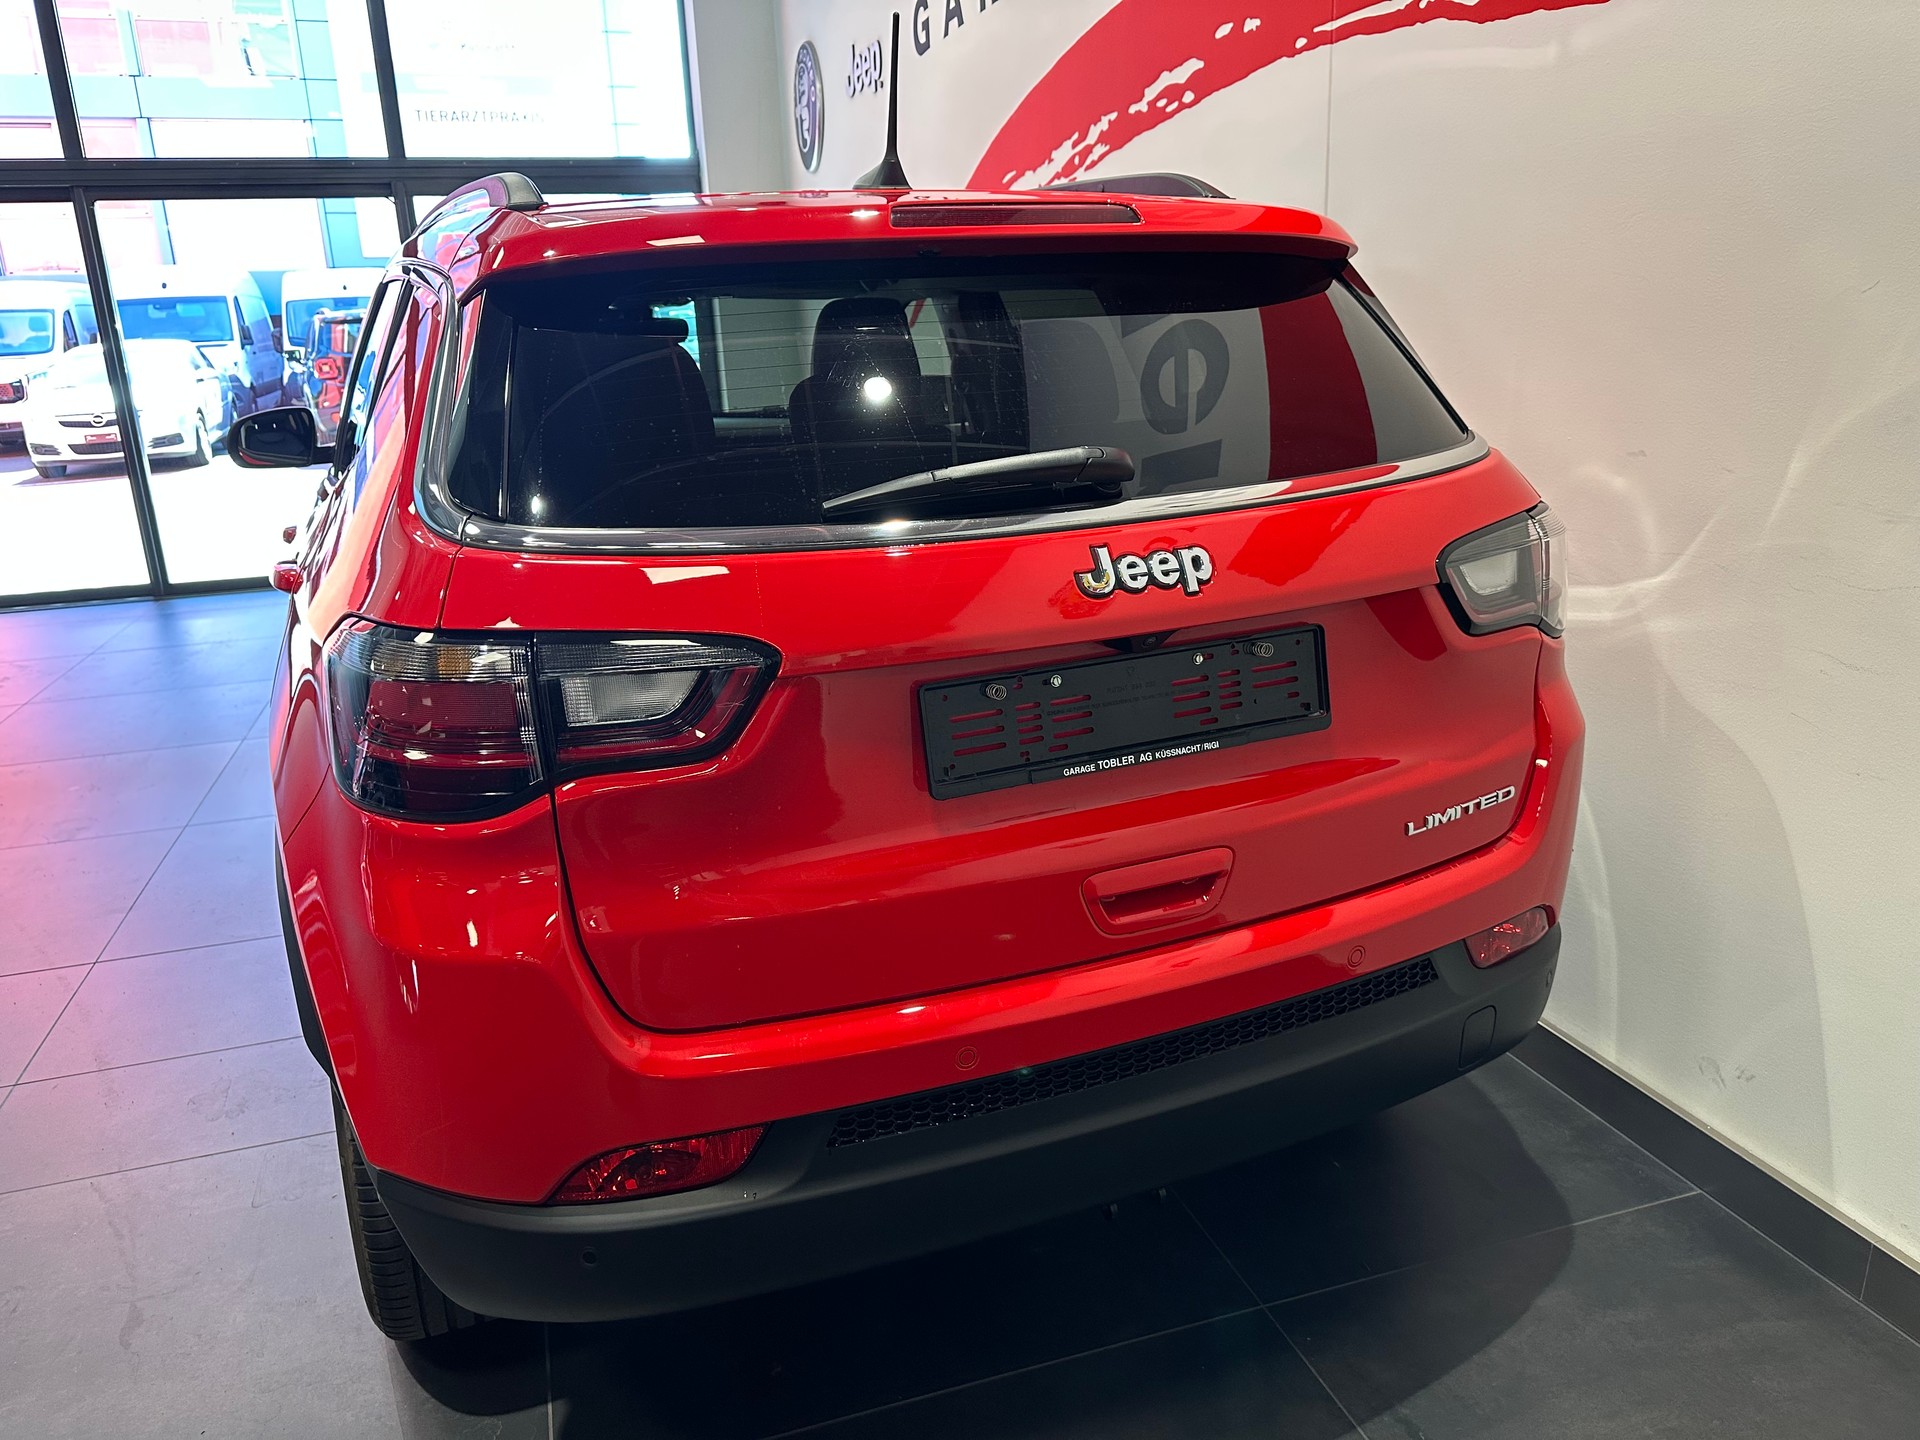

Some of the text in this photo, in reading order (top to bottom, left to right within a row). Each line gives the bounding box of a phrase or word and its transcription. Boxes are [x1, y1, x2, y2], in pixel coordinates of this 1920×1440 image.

[913, 0, 999, 56] GA
[846, 39, 884, 98] Jeep
[1075, 542, 1214, 598] Jeep
[1063, 763, 1096, 777] GARAGE
[1097, 755, 1135, 770] TOBLER
[1139, 752, 1153, 763] AG
[1405, 785, 1516, 836] LIMITED
